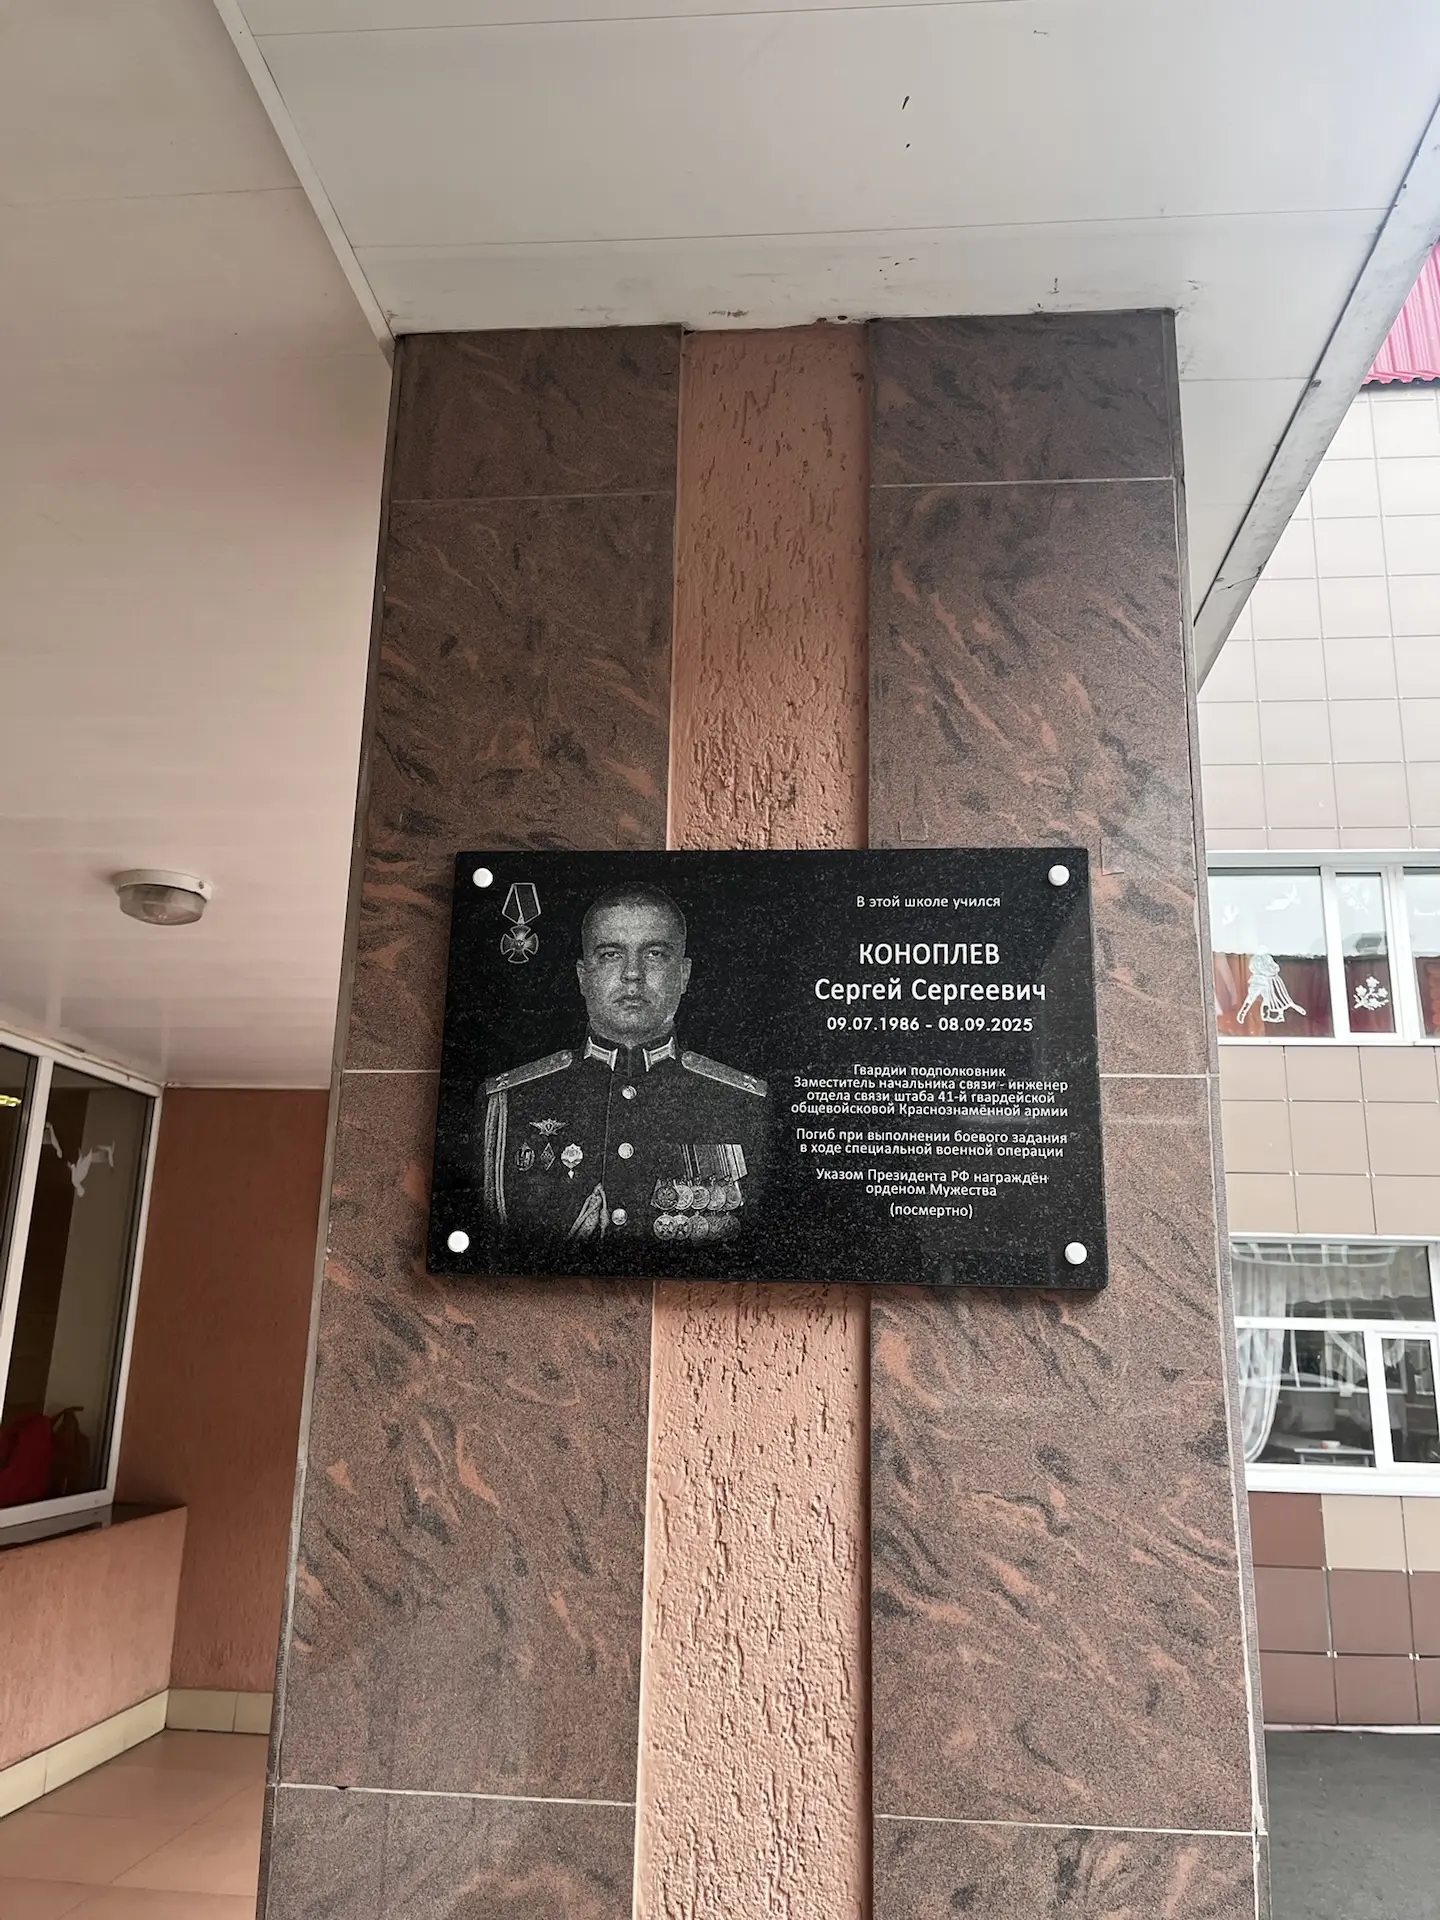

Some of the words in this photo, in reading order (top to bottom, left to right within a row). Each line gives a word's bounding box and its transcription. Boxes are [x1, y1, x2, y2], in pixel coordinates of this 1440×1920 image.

[856, 896, 865, 908] В
[869, 895, 900, 908] этой
[904, 898, 949, 908] школе
[953, 897, 1001, 910] учился
[859, 943, 1000, 965] КОНОПЛЕВ
[814, 977, 902, 1005] Сергей
[911, 978, 1046, 1005] Сергеевич
[826, 1016, 920, 1031] 09.07.1986
[938, 1017, 1034, 1032] 08.09.2025
[853, 1064, 907, 1078] Гвардии
[910, 1066, 1006, 1079] подполковник
[793, 1076, 876, 1089] Заместитель
[879, 1079, 956, 1090] начальника
[959, 1080, 996, 1091] связи
[1008, 1080, 1069, 1093] инженер
[806, 1090, 851, 1103] отдела
[854, 1091, 890, 1102] связи
[894, 1090, 935, 1102] штаба
[937, 1090, 968, 1103] 41-й
[971, 1092, 1056, 1106] гвардейской
[791, 1101, 895, 1116] общевойсковой
[899, 1103, 1021, 1118] Краснознамённой
[1024, 1107, 1069, 1120] армии
[796, 1128, 836, 1140] Погиб
[839, 1130, 864, 1143] при
[867, 1131, 951, 1142] выполнении
[954, 1130, 1009, 1144] боевого
[1012, 1133, 1068, 1146] задания
[800, 1144, 808, 1153] в
[811, 1144, 842, 1155] ходе
[845, 1142, 933, 1156] специальной
[936, 1144, 994, 1156] военной
[997, 1147, 1064, 1160] операции
[815, 1168, 864, 1181] Указом
[867, 1169, 947, 1184] Президента
[951, 1169, 970, 1183] РФ
[973, 1171, 1049, 1185] награждён
[865, 1185, 926, 1197] орденом
[930, 1184, 997, 1198] Мужества
[890, 1203, 974, 1219] (посмертно)
